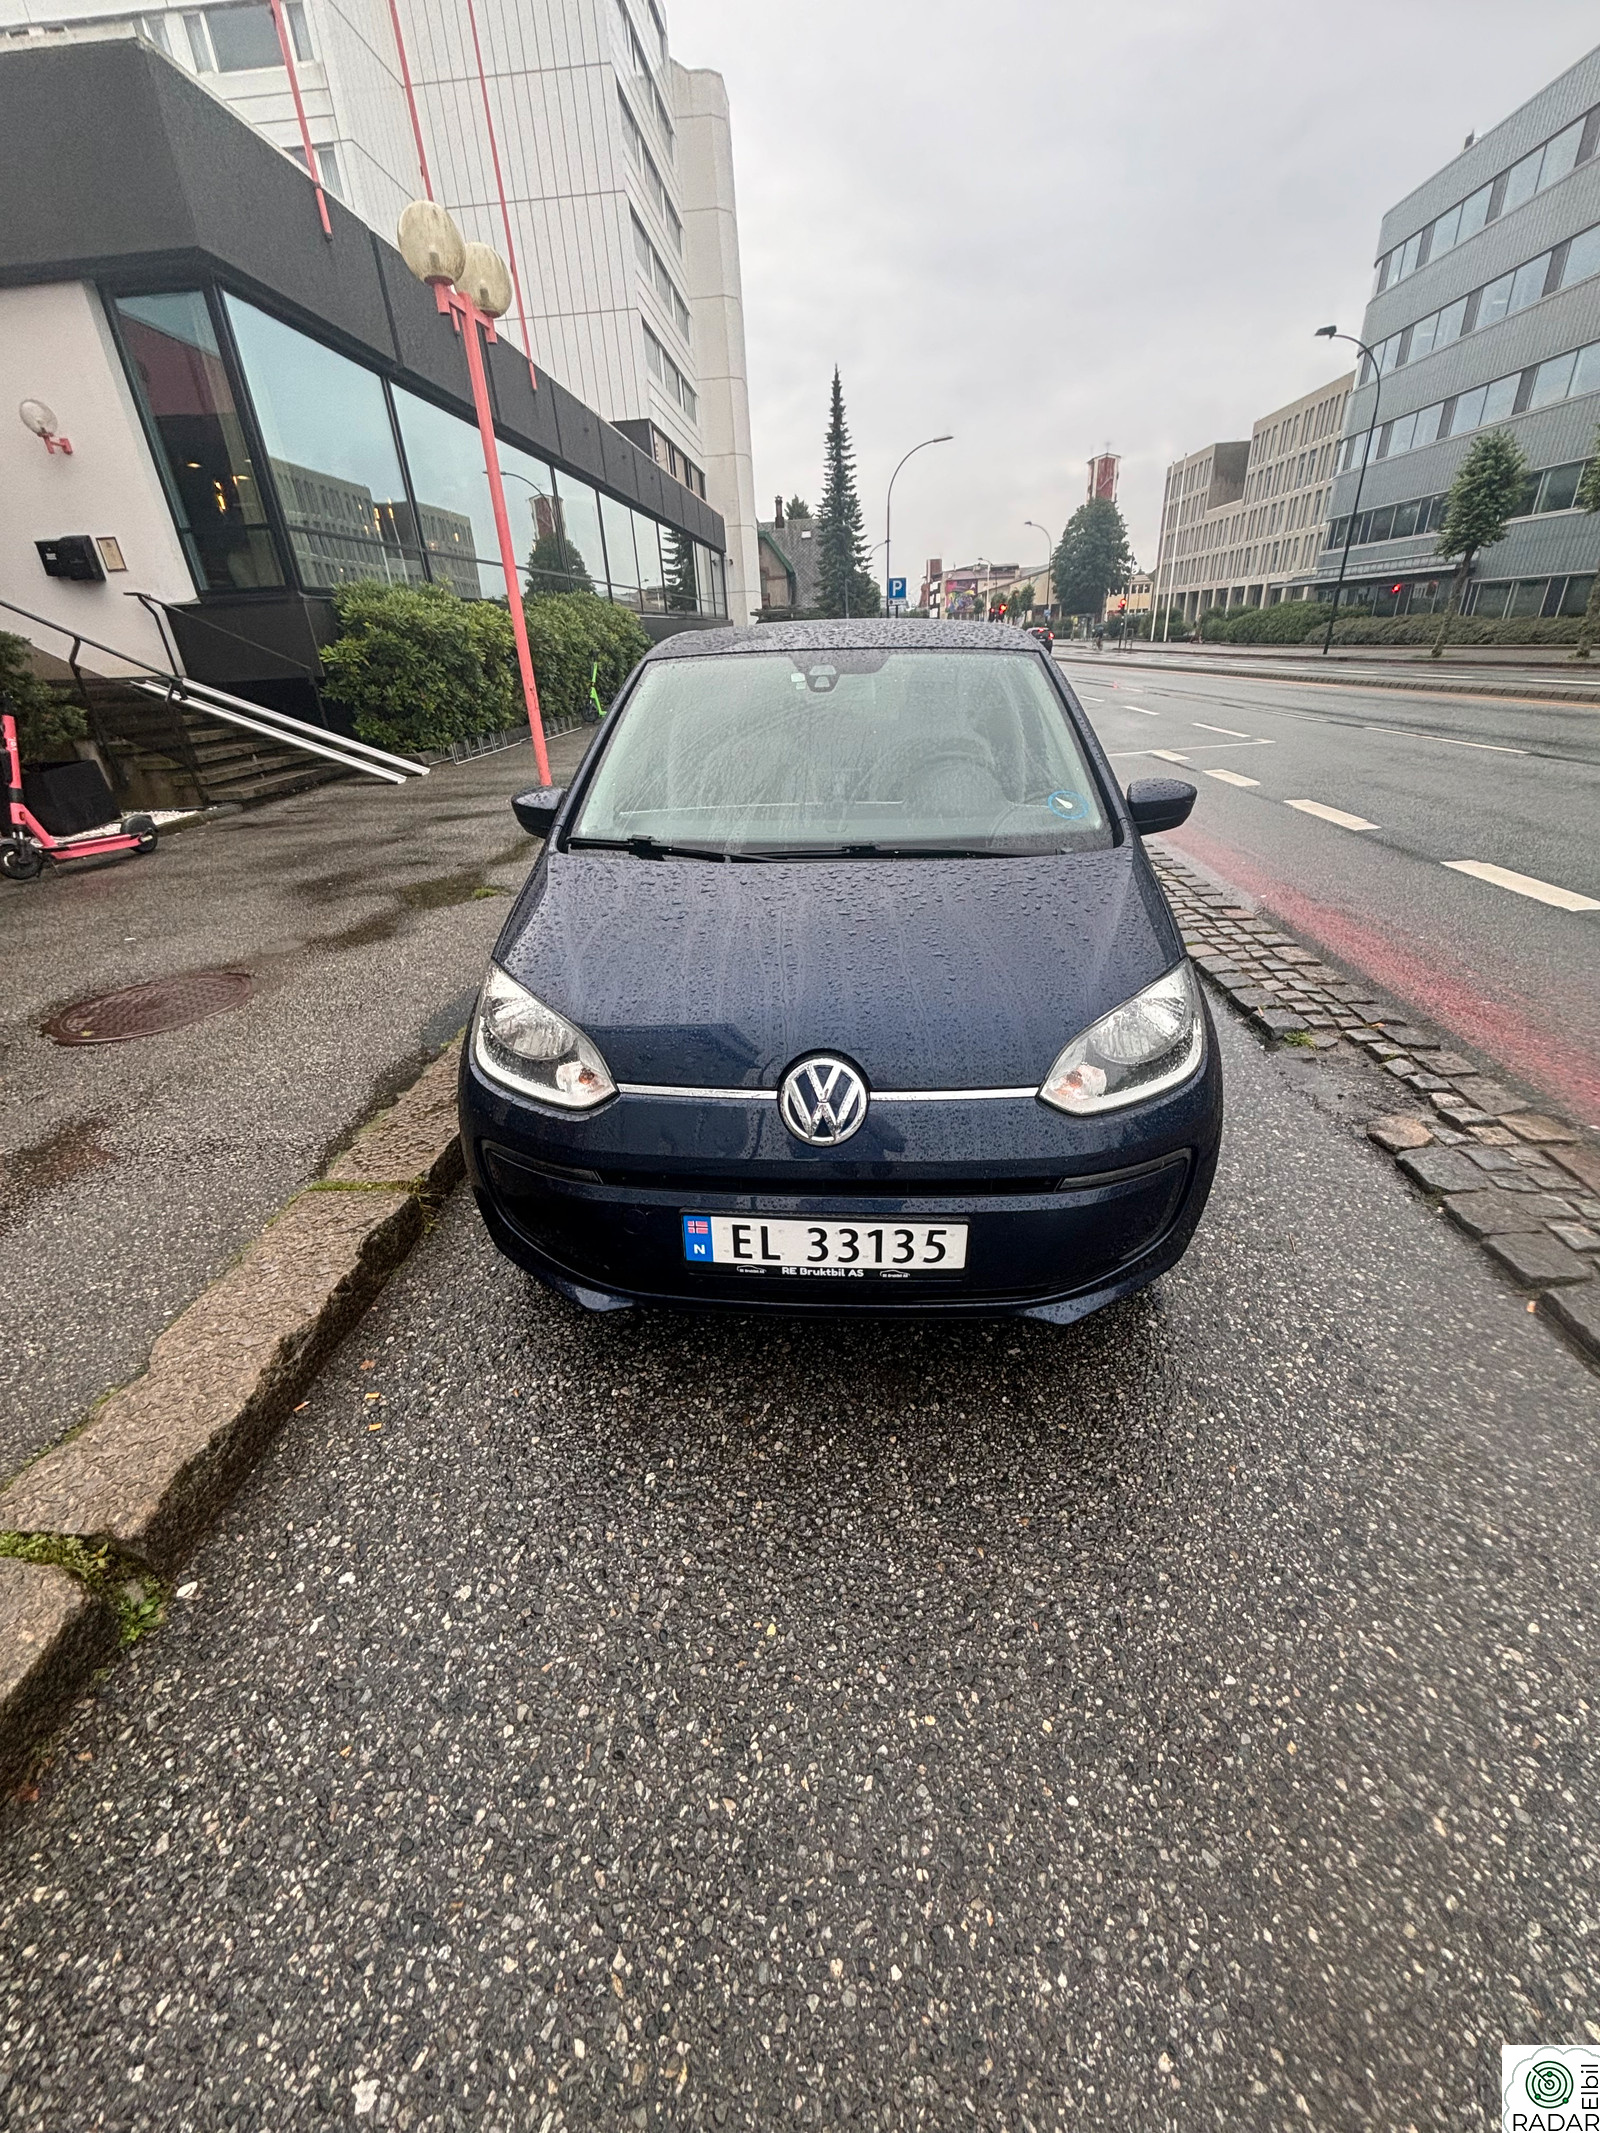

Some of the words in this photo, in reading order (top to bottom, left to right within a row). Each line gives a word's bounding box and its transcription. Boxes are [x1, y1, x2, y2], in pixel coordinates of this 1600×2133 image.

[892, 580, 903, 596] P
[783, 1059, 866, 1144] VW
[693, 1243, 706, 1255] N
[732, 1224, 781, 1261] EL
[806, 1227, 947, 1263] 33135
[781, 1266, 798, 1276] RE
[799, 1267, 846, 1278] Bruktbil
[847, 1268, 865, 1278] AS
